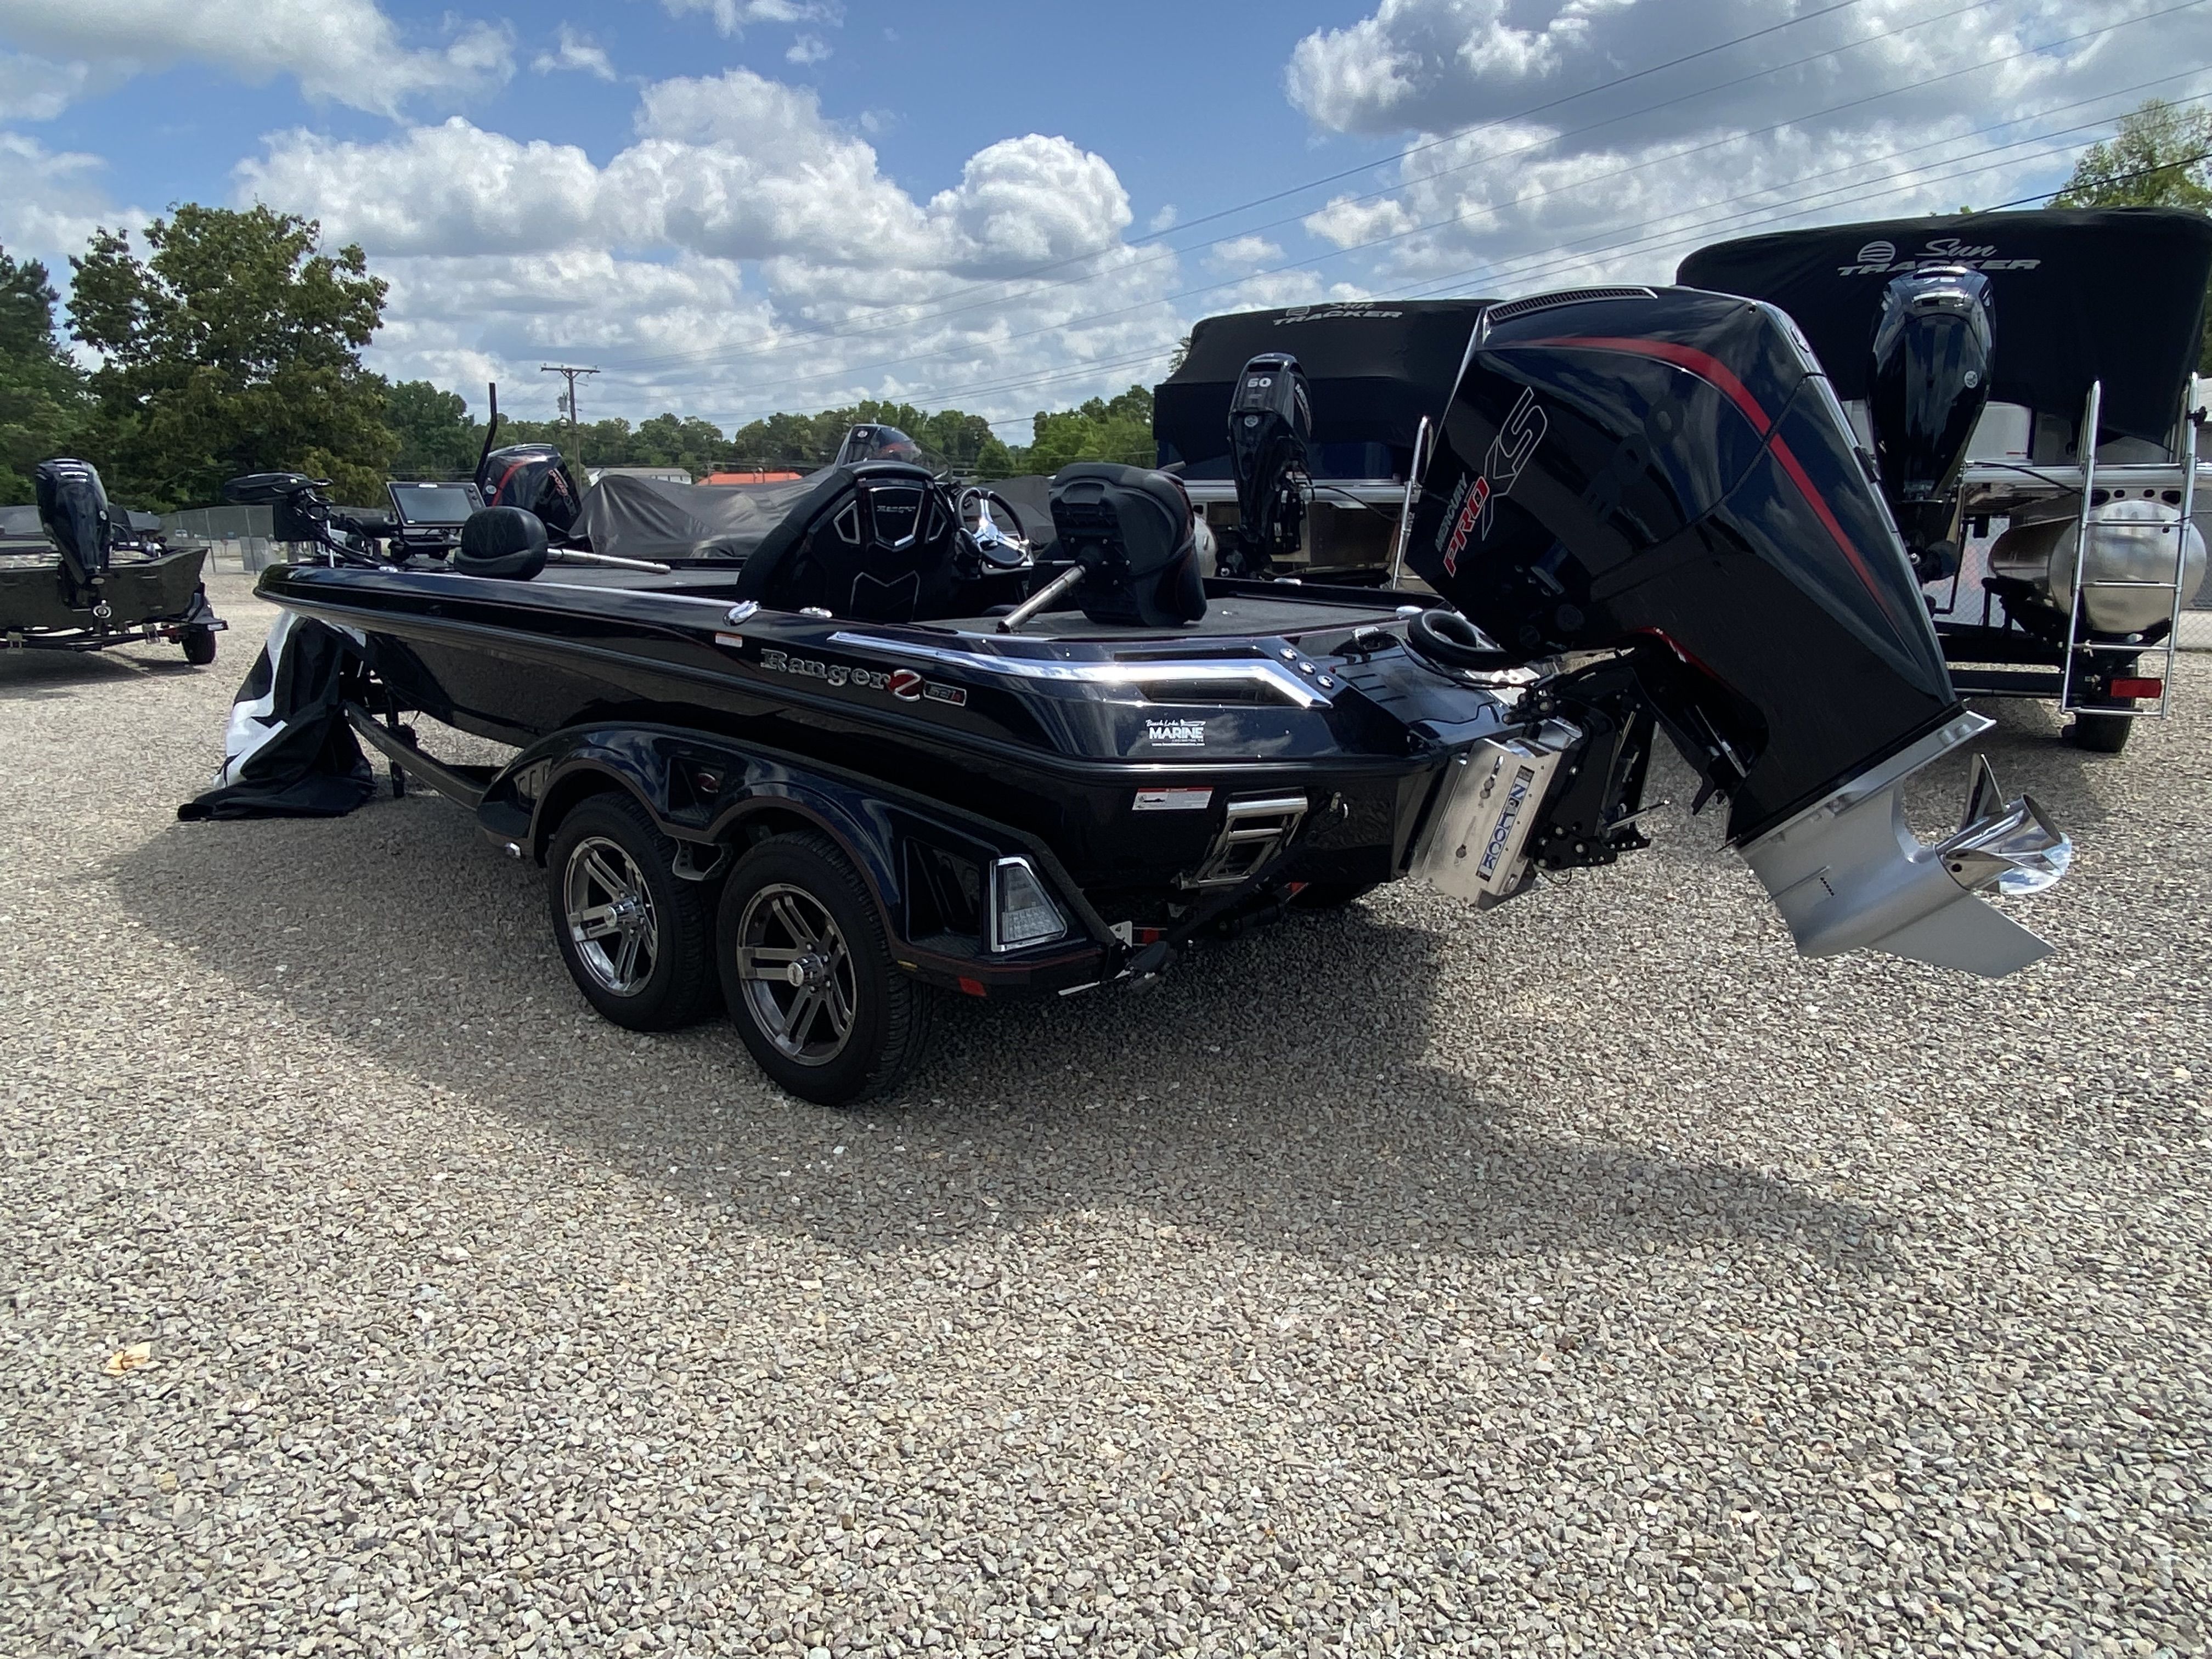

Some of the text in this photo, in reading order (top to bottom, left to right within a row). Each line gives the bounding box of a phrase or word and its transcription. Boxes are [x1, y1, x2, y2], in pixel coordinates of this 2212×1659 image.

[1915, 238, 1998, 258] Sun
[1837, 259, 2041, 276] TRACKER
[1272, 310, 1403, 326] TRACKER
[1247, 377, 1272, 387] 60
[1435, 472, 1468, 552] MERCURY
[760, 648, 891, 687] Ranger
[893, 669, 921, 702] Z
[1149, 726, 1204, 740] MARINE
